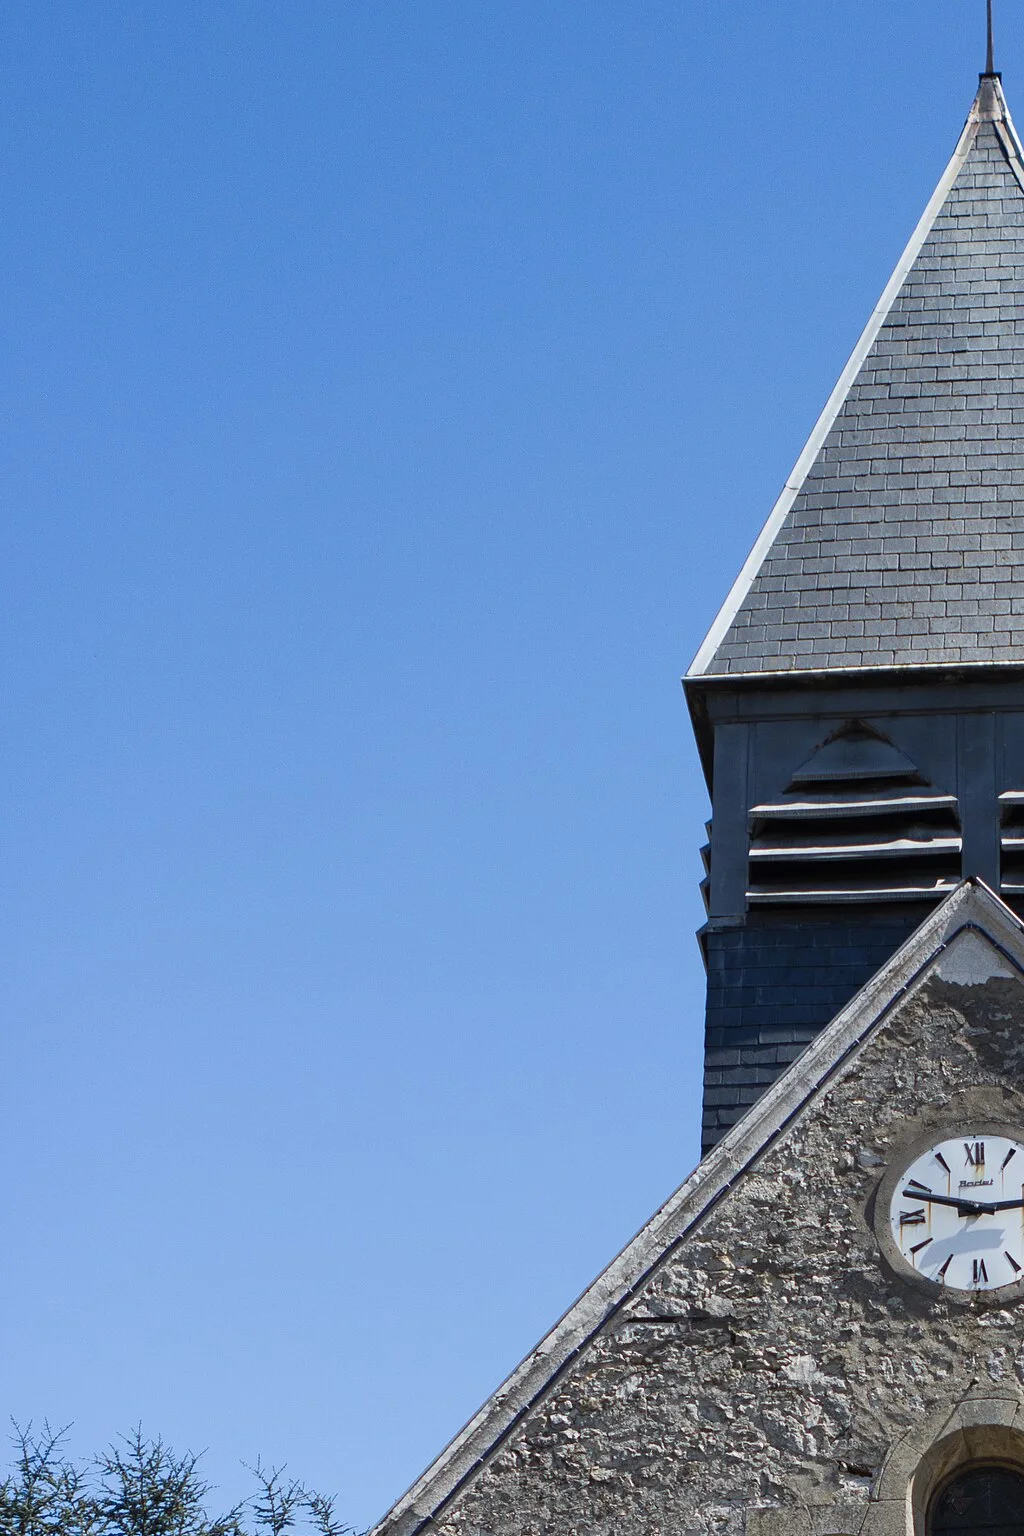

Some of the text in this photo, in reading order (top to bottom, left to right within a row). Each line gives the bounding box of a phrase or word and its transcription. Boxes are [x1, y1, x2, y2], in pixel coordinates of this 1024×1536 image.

[963, 1142, 985, 1167] XII
[958, 1178, 994, 1188] Bodet
[899, 1208, 926, 1224] IX
[972, 1257, 989, 1283] VI
